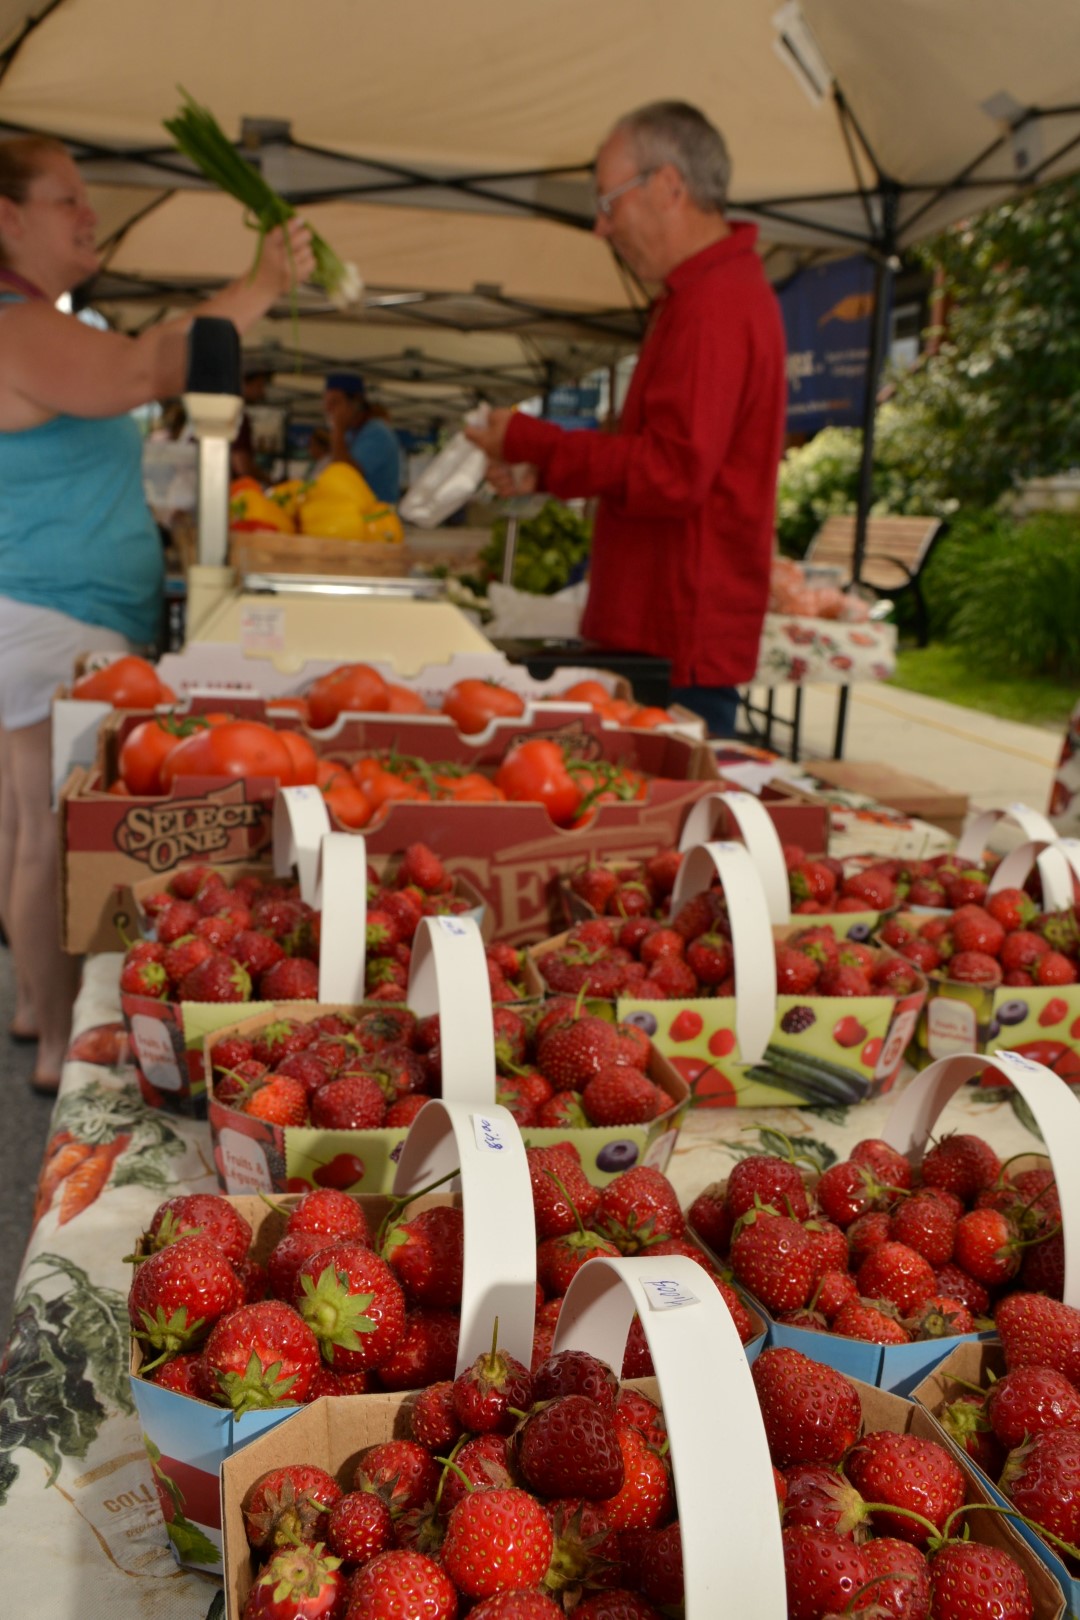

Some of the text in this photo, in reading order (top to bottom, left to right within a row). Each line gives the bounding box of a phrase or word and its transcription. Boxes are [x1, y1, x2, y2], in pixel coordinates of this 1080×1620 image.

[127, 803, 262, 850] SELECT
[150, 828, 228, 871] ONE
[225, 1149, 265, 1176] Fruits &
[103, 1479, 158, 1513] COLL
